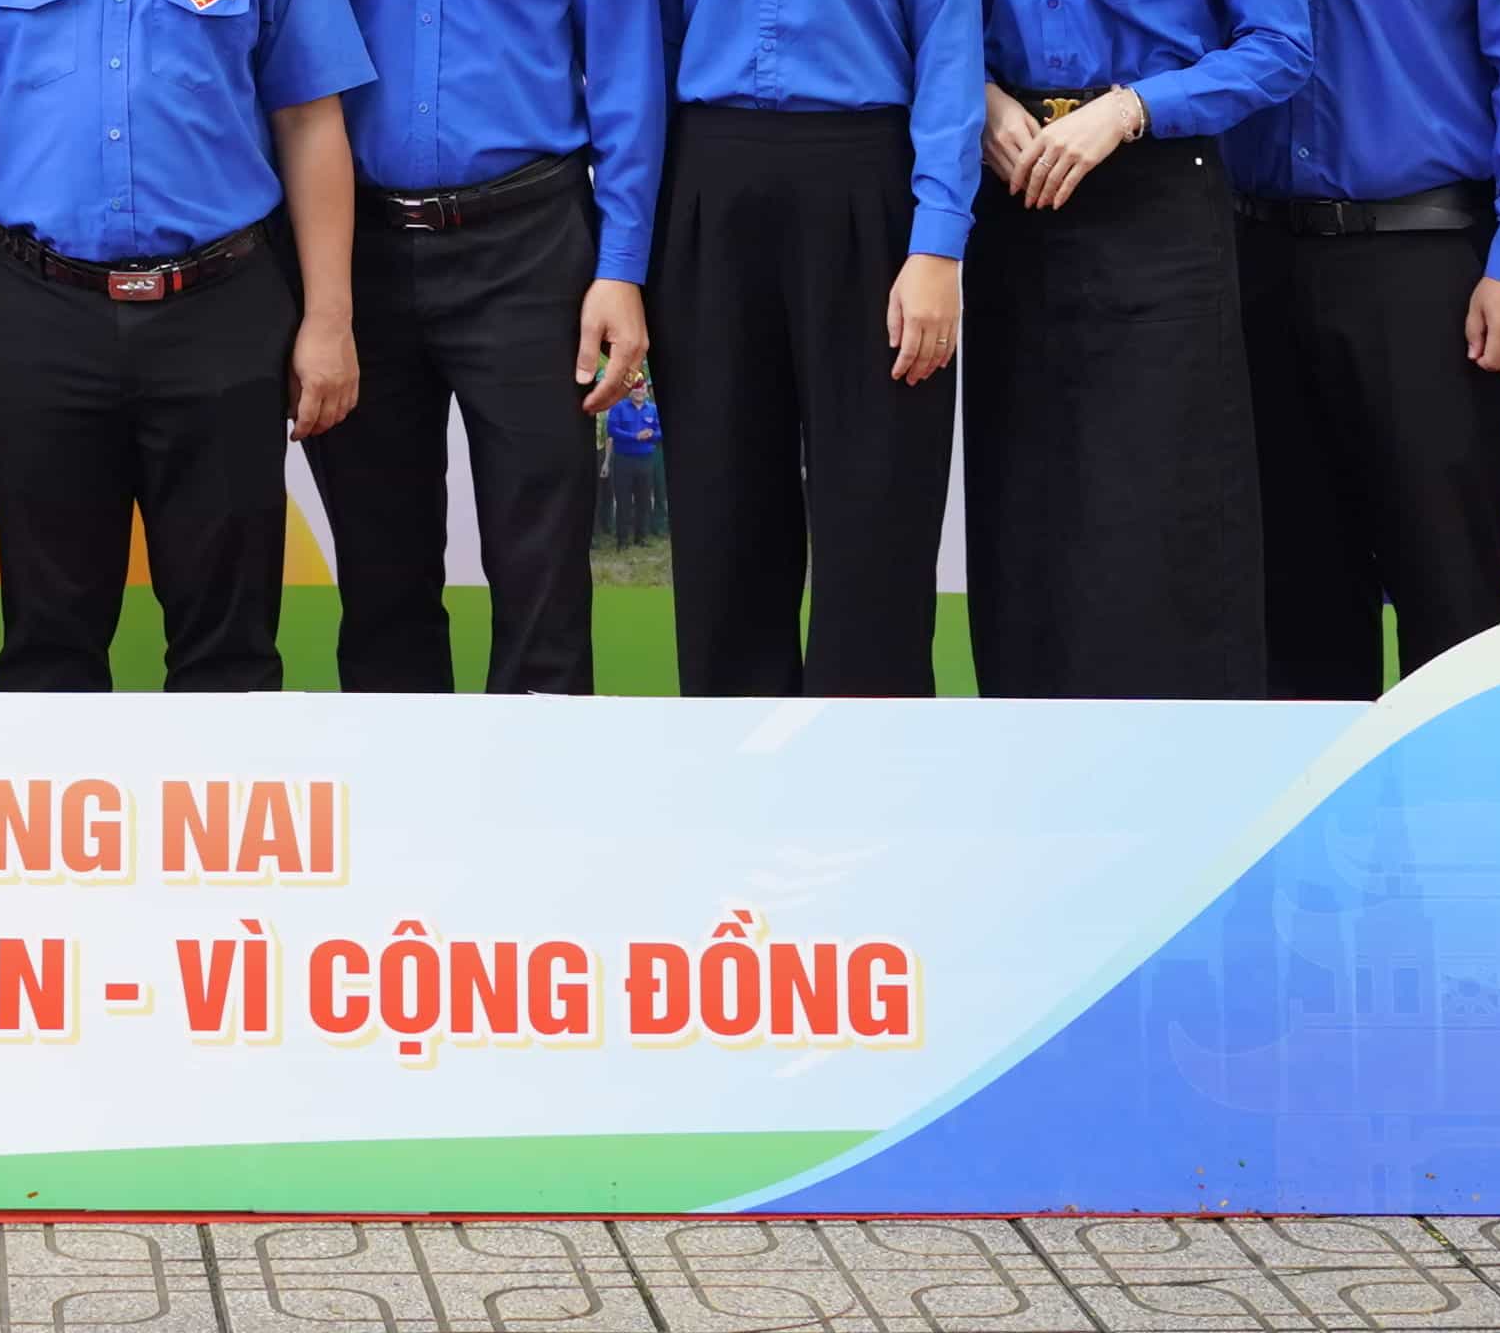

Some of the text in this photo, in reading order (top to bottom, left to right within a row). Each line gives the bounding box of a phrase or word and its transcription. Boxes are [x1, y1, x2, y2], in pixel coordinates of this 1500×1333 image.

[163, 781, 333, 872] NAI
[106, 984, 138, 1000] -
[176, 919, 267, 1031] VÌ
[310, 921, 588, 1055] CỘNG
[625, 910, 908, 1036] ĐỒNG
